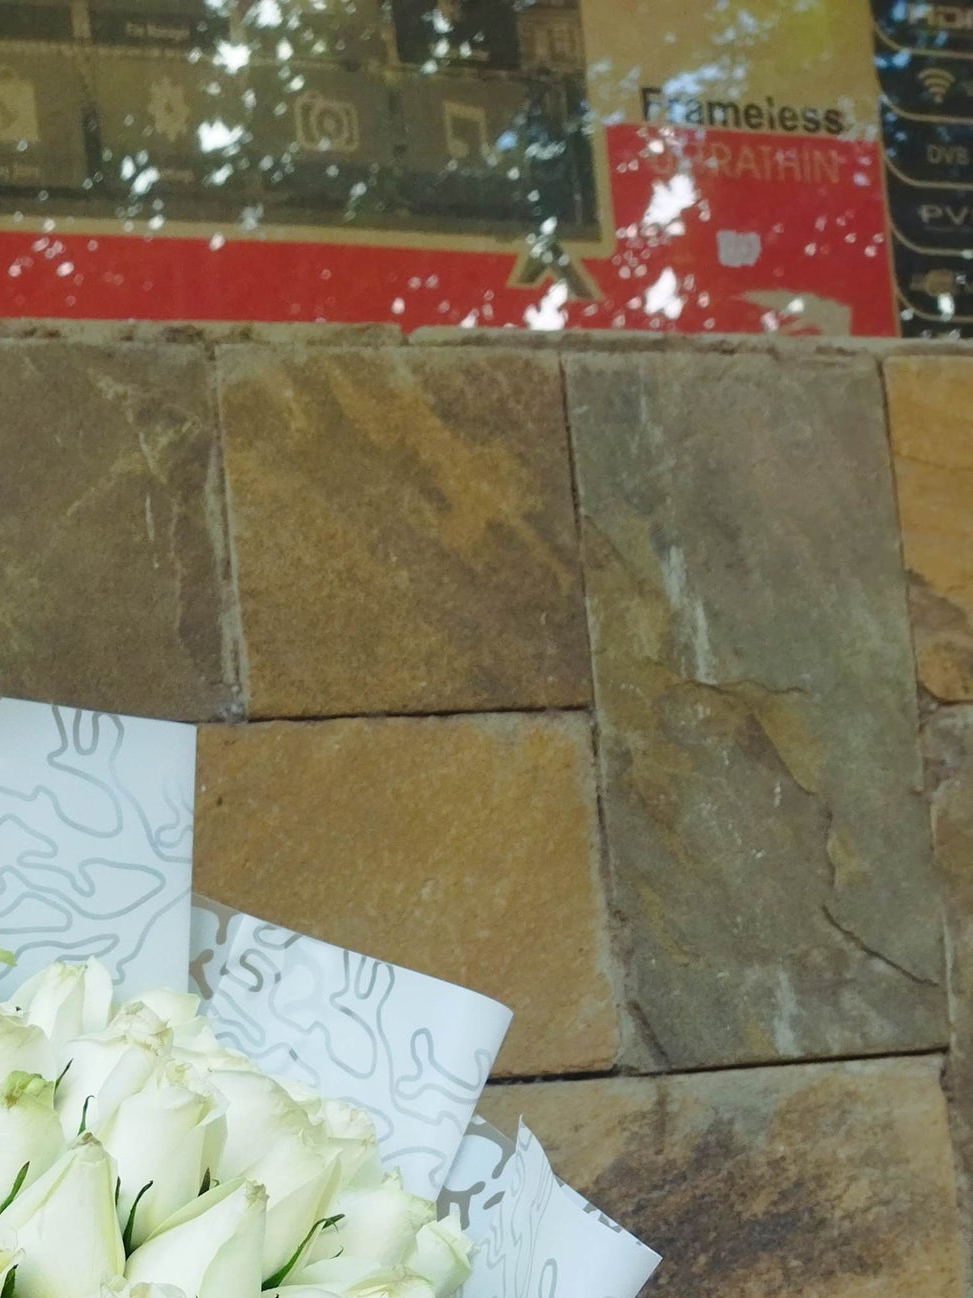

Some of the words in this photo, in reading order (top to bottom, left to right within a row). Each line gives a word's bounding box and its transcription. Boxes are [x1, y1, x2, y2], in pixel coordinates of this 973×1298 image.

[641, 86, 845, 135] Frameless
[649, 141, 840, 184] URATHIN
[920, 203, 973, 226] PV
